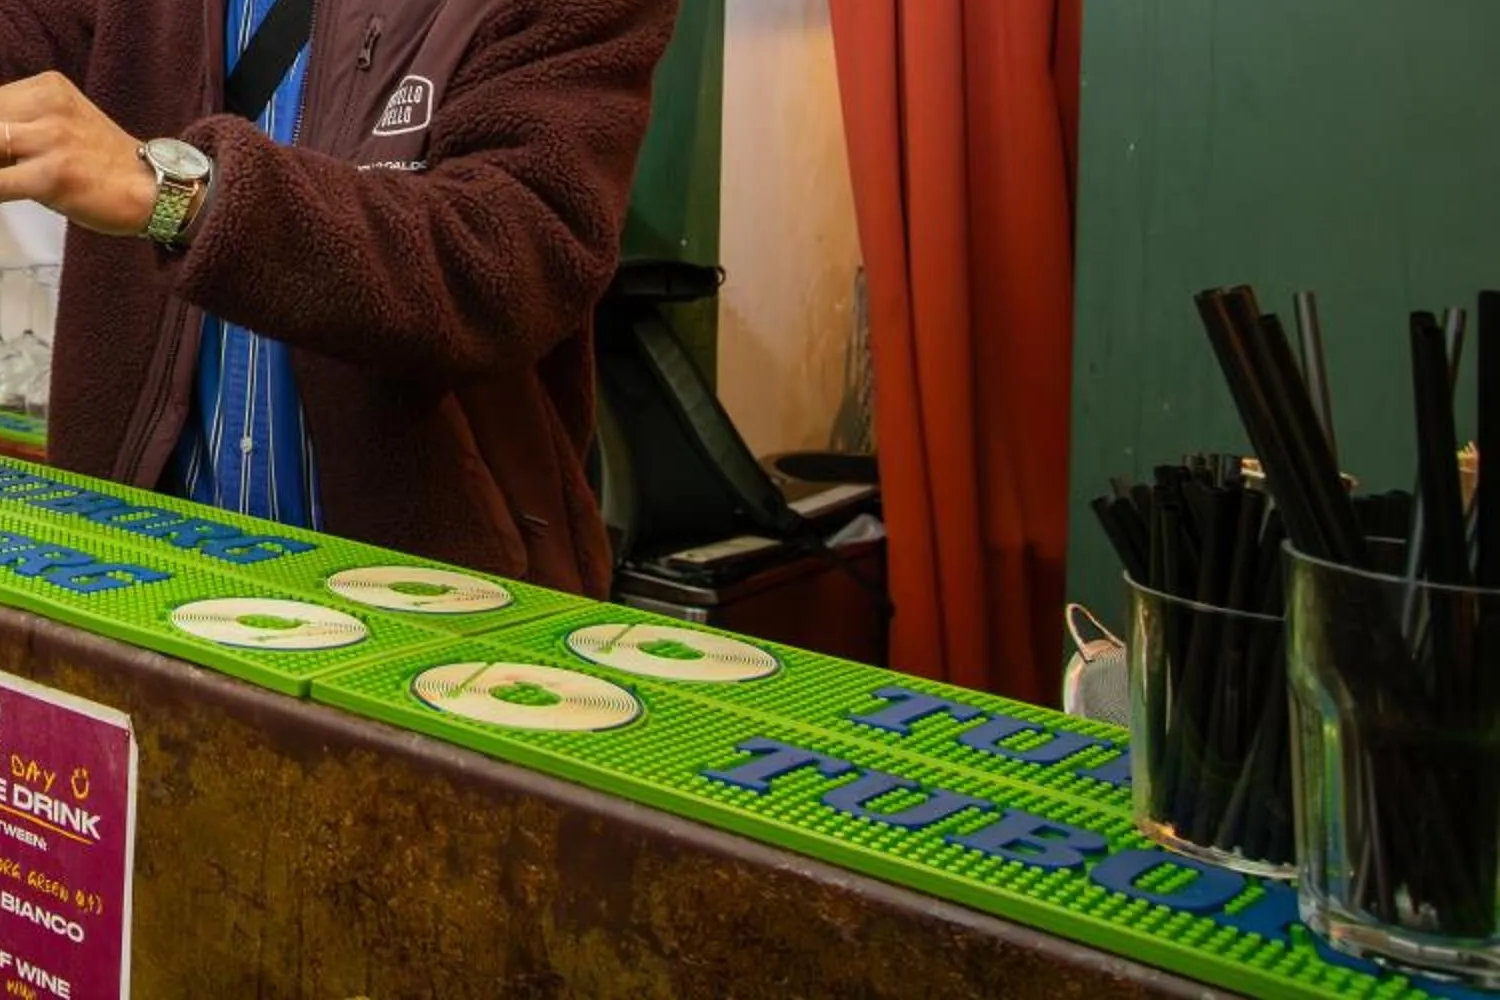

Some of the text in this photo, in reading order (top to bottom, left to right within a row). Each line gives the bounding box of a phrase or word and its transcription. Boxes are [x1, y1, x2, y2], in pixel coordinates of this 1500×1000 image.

[846, 686, 1133, 786] TU
[11, 754, 56, 793] DAY
[12, 782, 102, 841] DRINK
[1, 893, 85, 943] BIANCO
[15, 956, 72, 1000] WINE
